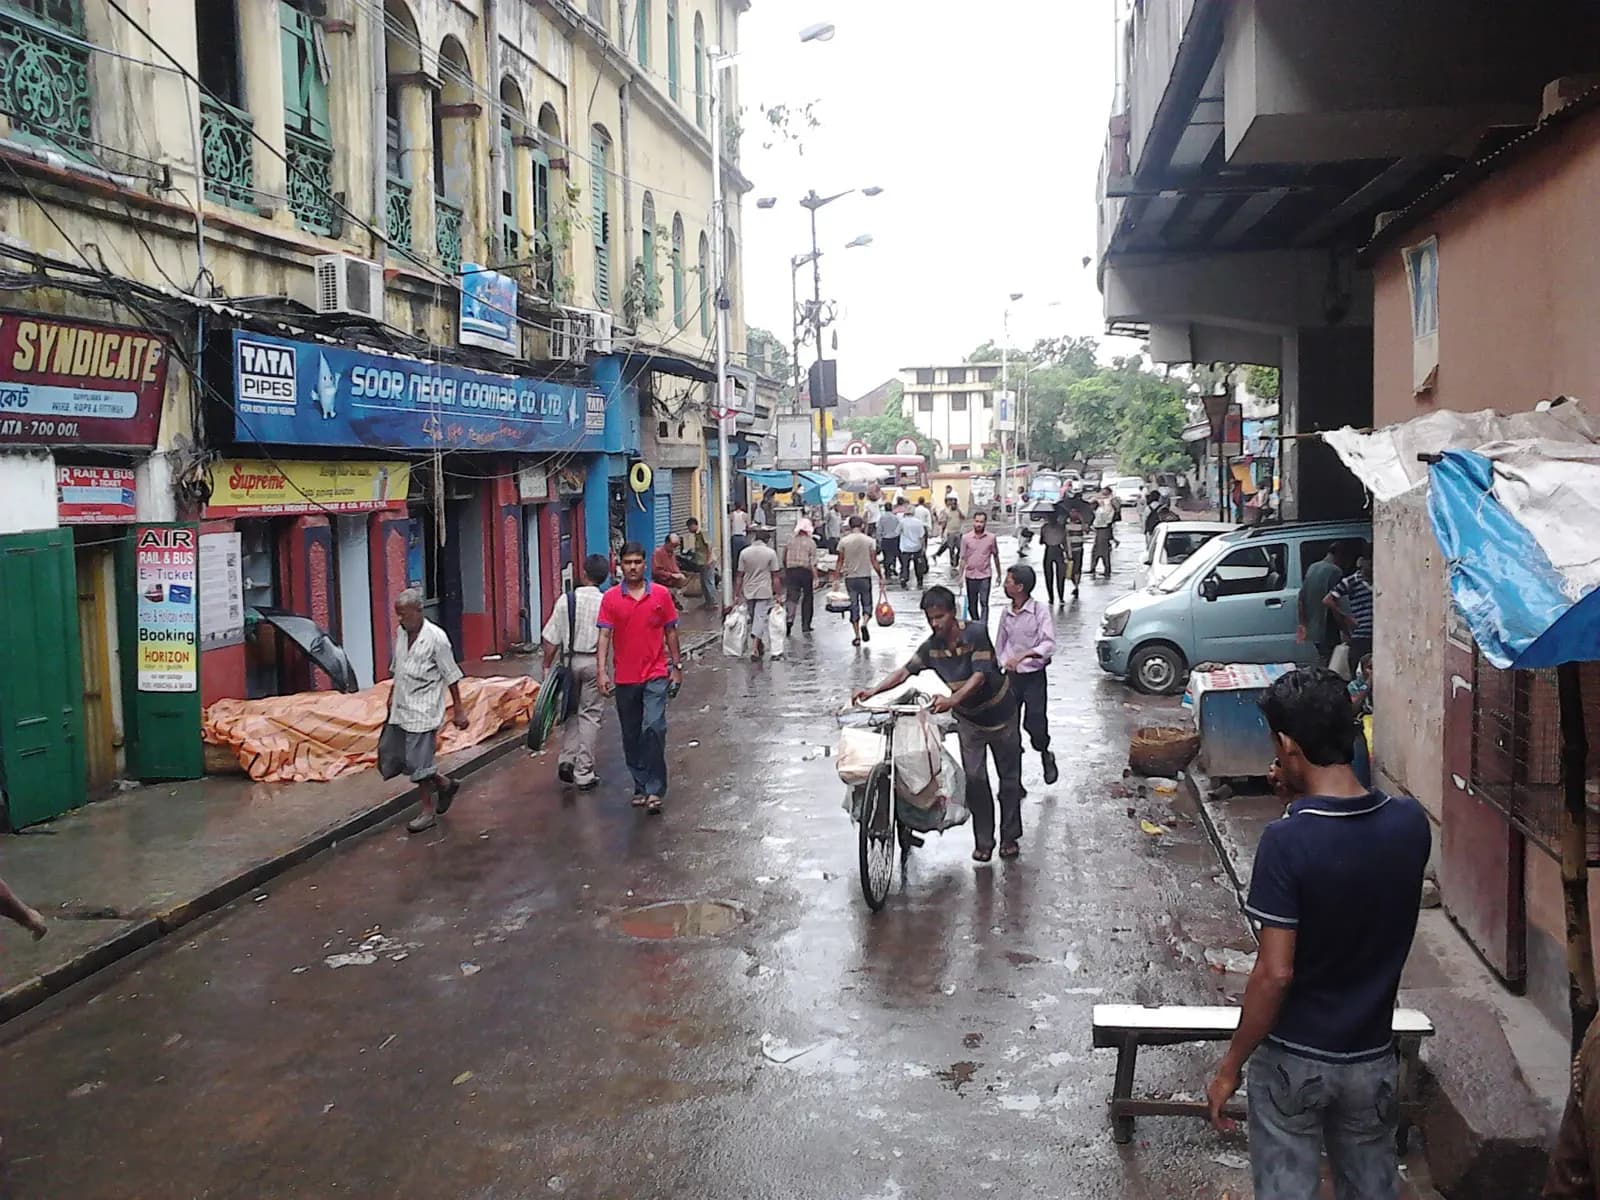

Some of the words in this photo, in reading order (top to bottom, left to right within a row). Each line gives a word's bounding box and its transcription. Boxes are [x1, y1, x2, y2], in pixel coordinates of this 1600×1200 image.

[13, 321, 162, 382] SYNDICATE
[242, 346, 293, 377] TATA
[244, 378, 293, 397] PIPES
[351, 366, 404, 400] SOOR
[409, 373, 458, 405] NEOGI
[520, 390, 537, 414] CO.
[540, 393, 563, 415] LTD.
[587, 397, 604, 411] TATA
[0, 420, 22, 435] ATA
[31, 421, 55, 436] 700
[73, 468, 100, 479] RAIL
[102, 470, 110, 479] &
[113, 469, 135, 480] BUS
[229, 463, 285, 496] Supreme
[139, 530, 193, 548] AIR
[140, 551, 161, 564] RAIL
[163, 551, 170, 564] &
[173, 551, 194, 565] BUS
[156, 568, 193, 580] Ticket
[140, 628, 194, 645] Booking
